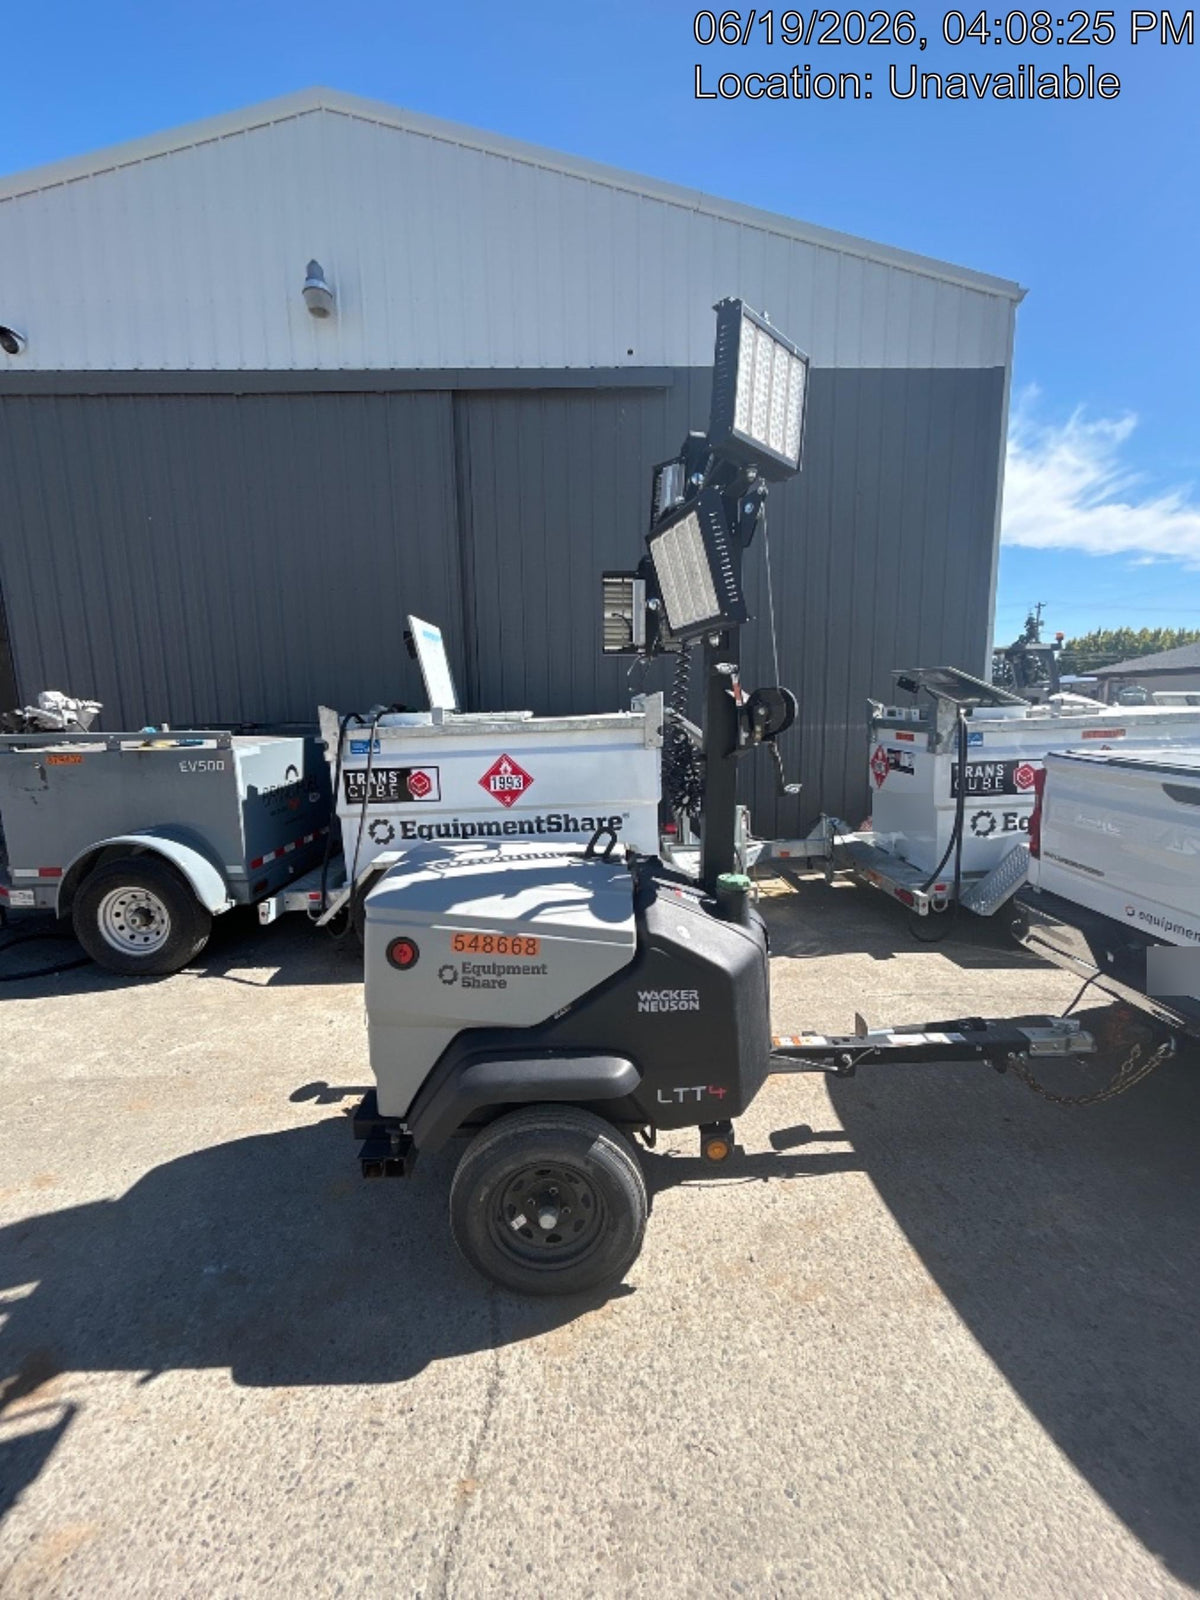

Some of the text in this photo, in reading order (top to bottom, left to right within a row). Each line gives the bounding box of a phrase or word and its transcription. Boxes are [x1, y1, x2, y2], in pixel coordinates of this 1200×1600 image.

[179, 760, 225, 772] EV500
[347, 771, 398, 785] TRANS
[492, 776, 522, 790] 1993
[453, 933, 537, 956] 548668
[461, 962, 548, 977] Equipment
[461, 976, 508, 989] Share
[637, 989, 700, 1001] WACKER
[637, 1000, 700, 1013] NEUSON
[657, 1085, 727, 1103] LTT4
